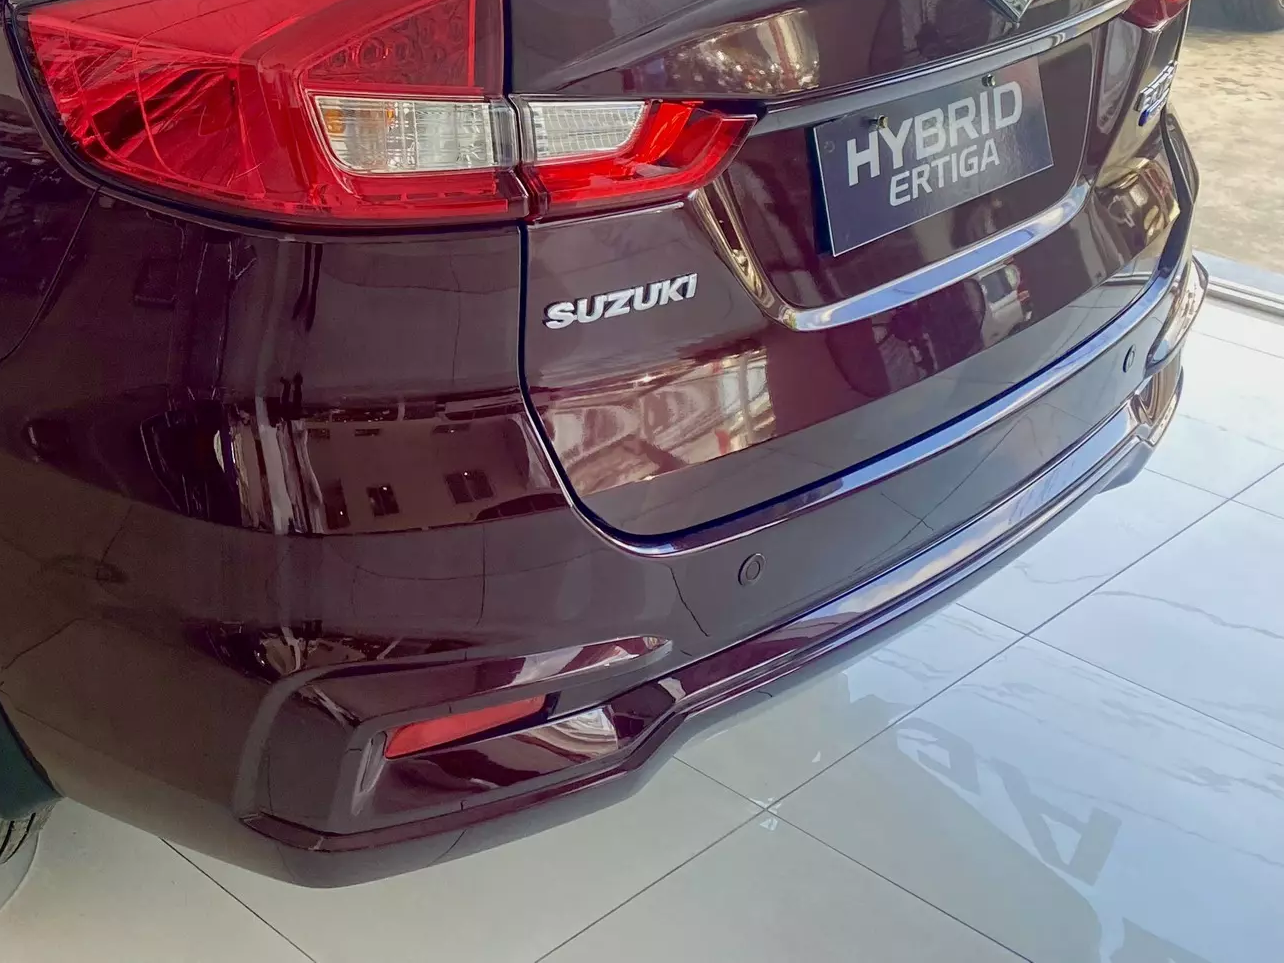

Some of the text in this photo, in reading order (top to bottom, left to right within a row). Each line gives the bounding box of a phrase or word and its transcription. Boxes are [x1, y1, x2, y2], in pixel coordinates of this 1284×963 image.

[846, 80, 1023, 187] HYBRID
[888, 138, 1001, 207] ERTIGA
[543, 273, 698, 330] SUZUKI
